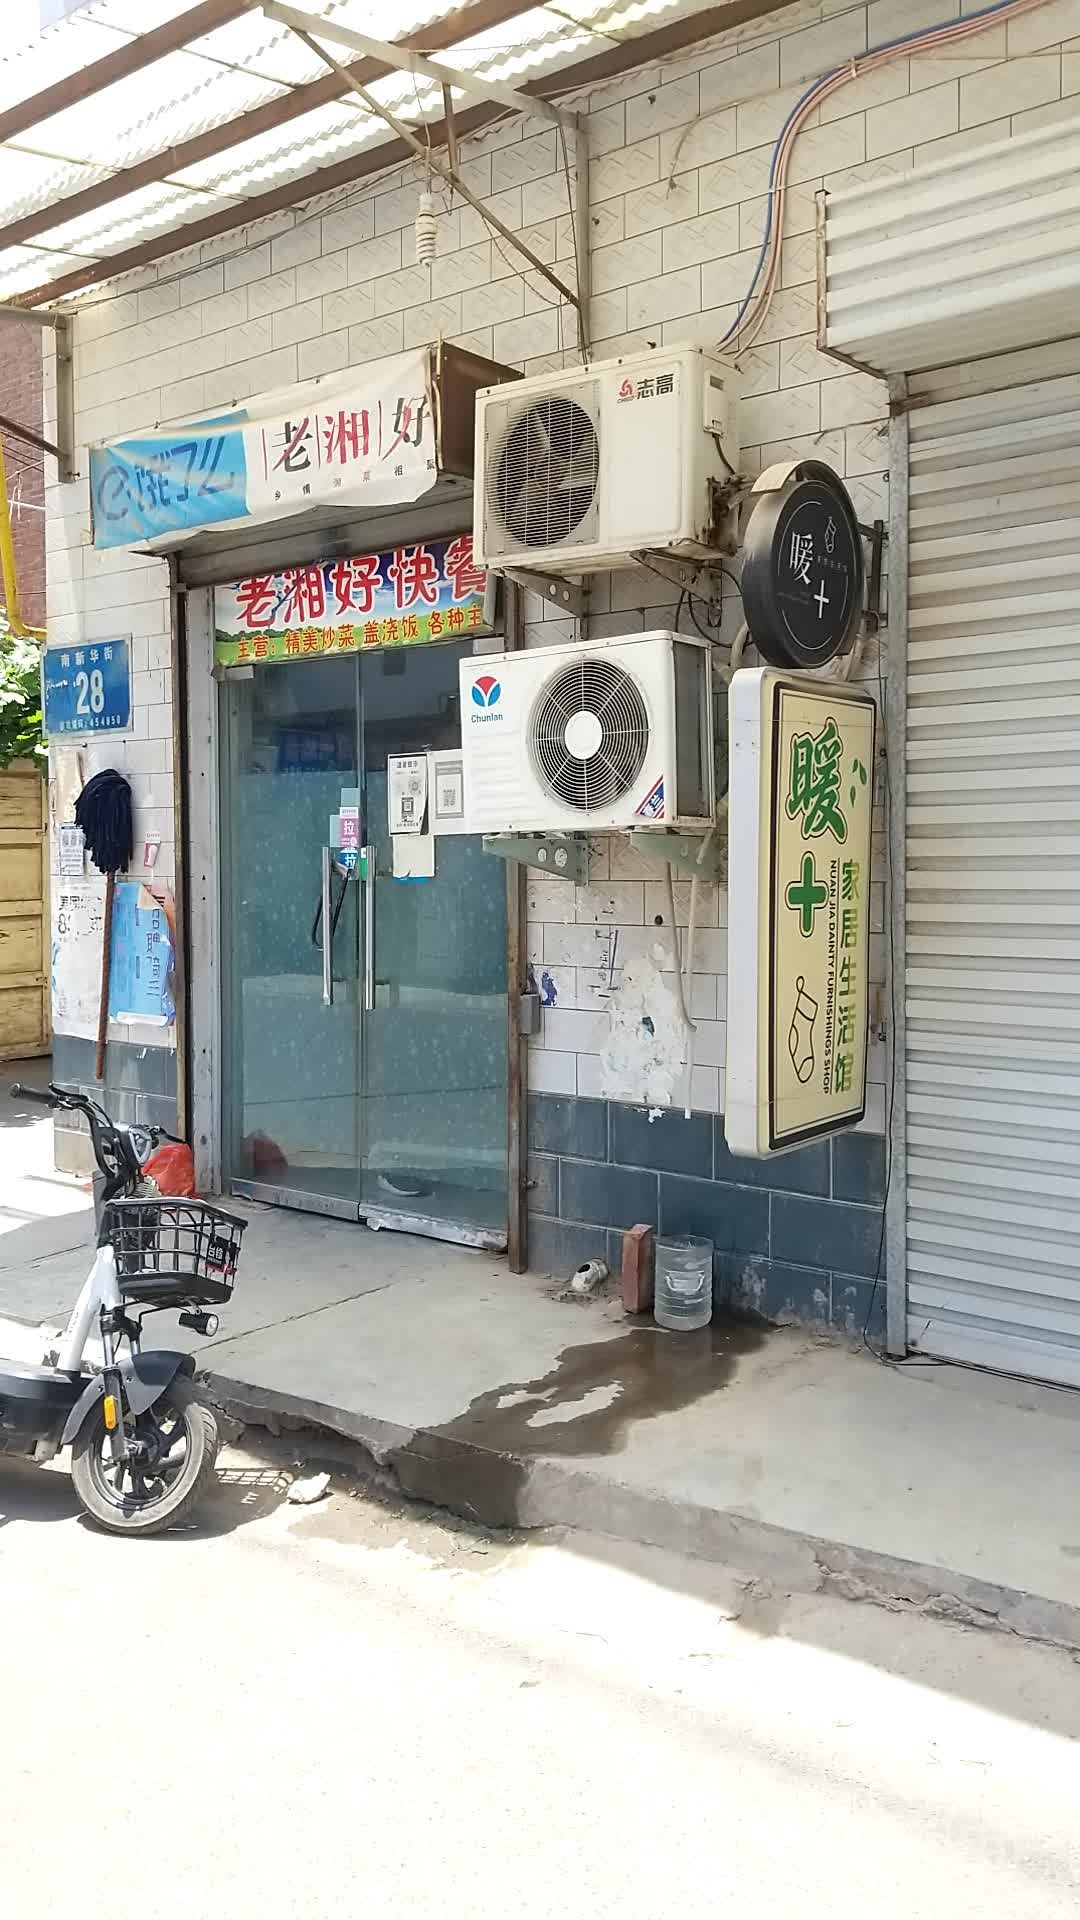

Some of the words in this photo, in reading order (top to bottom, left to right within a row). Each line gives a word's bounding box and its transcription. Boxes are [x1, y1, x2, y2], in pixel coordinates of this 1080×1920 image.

[636, 373, 675, 400] 志高
[270, 397, 432, 475] 老湘好
[235, 535, 487, 628] 老湘好快餐
[363, 613, 419, 646] 盖浇饭
[61, 646, 113, 668] 南新华街
[75, 669, 105, 715] 28
[470, 713, 504, 723] Chunlan
[785, 716, 847, 844] 暖
[343, 820, 355, 836] 拉
[829, 859, 838, 898] NUAN
[828, 899, 837, 920] JIA
[827, 921, 836, 968] DAINTY
[834, 858, 860, 1094] 家居生活馆
[824, 971, 835, 1057] FURNISHINGS
[822, 1059, 832, 1094] SHOP
